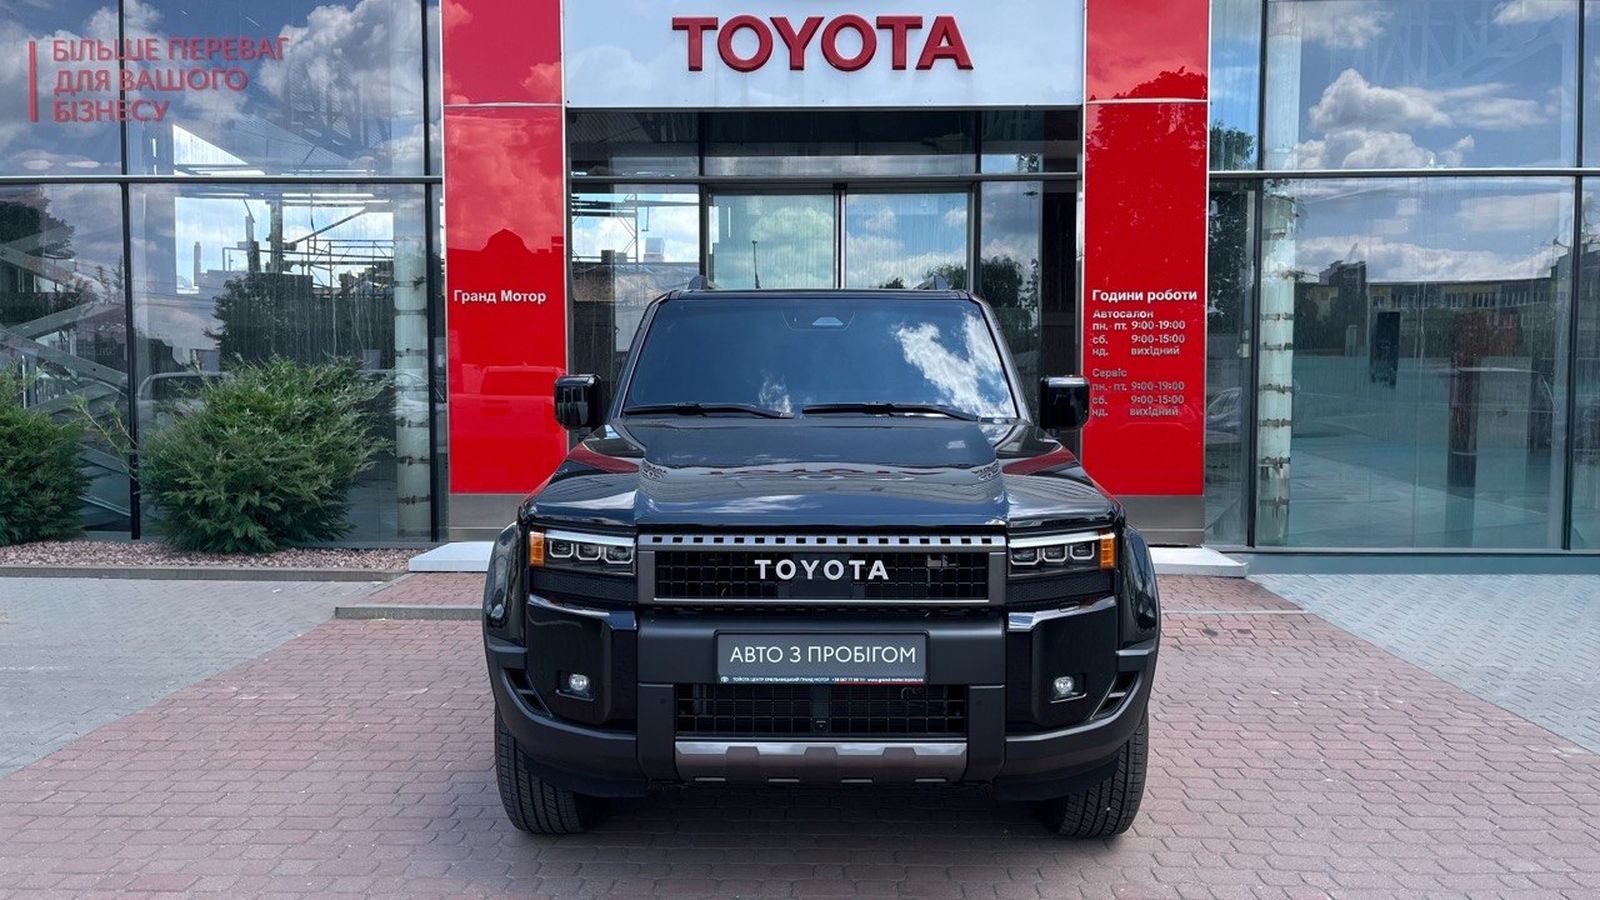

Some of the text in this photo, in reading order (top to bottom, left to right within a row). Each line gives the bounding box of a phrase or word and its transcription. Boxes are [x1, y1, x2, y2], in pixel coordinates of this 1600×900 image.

[53, 37, 289, 62] БІЛЬШЕ ПЕРЕВАГ
[671, 14, 975, 73] TOYOTA
[53, 67, 249, 96] ДЛЯ ВАШОГО
[53, 99, 170, 123] БІЗНЕСУ
[453, 289, 547, 304] Гранд Мотор
[1092, 289, 1198, 304] Години роботи
[1092, 309, 1154, 319] Автосалон
[1092, 335, 1108, 344] сб.
[1092, 346, 1180, 356] нд. вихідний
[1092, 368, 1128, 379] Сервіс
[1091, 396, 1108, 405] сб.
[1091, 406, 1179, 418] нд. вихідний
[754, 559, 889, 580] TOYOTA
[730, 646, 917, 663] АВТО З ПРОБІГОМ
